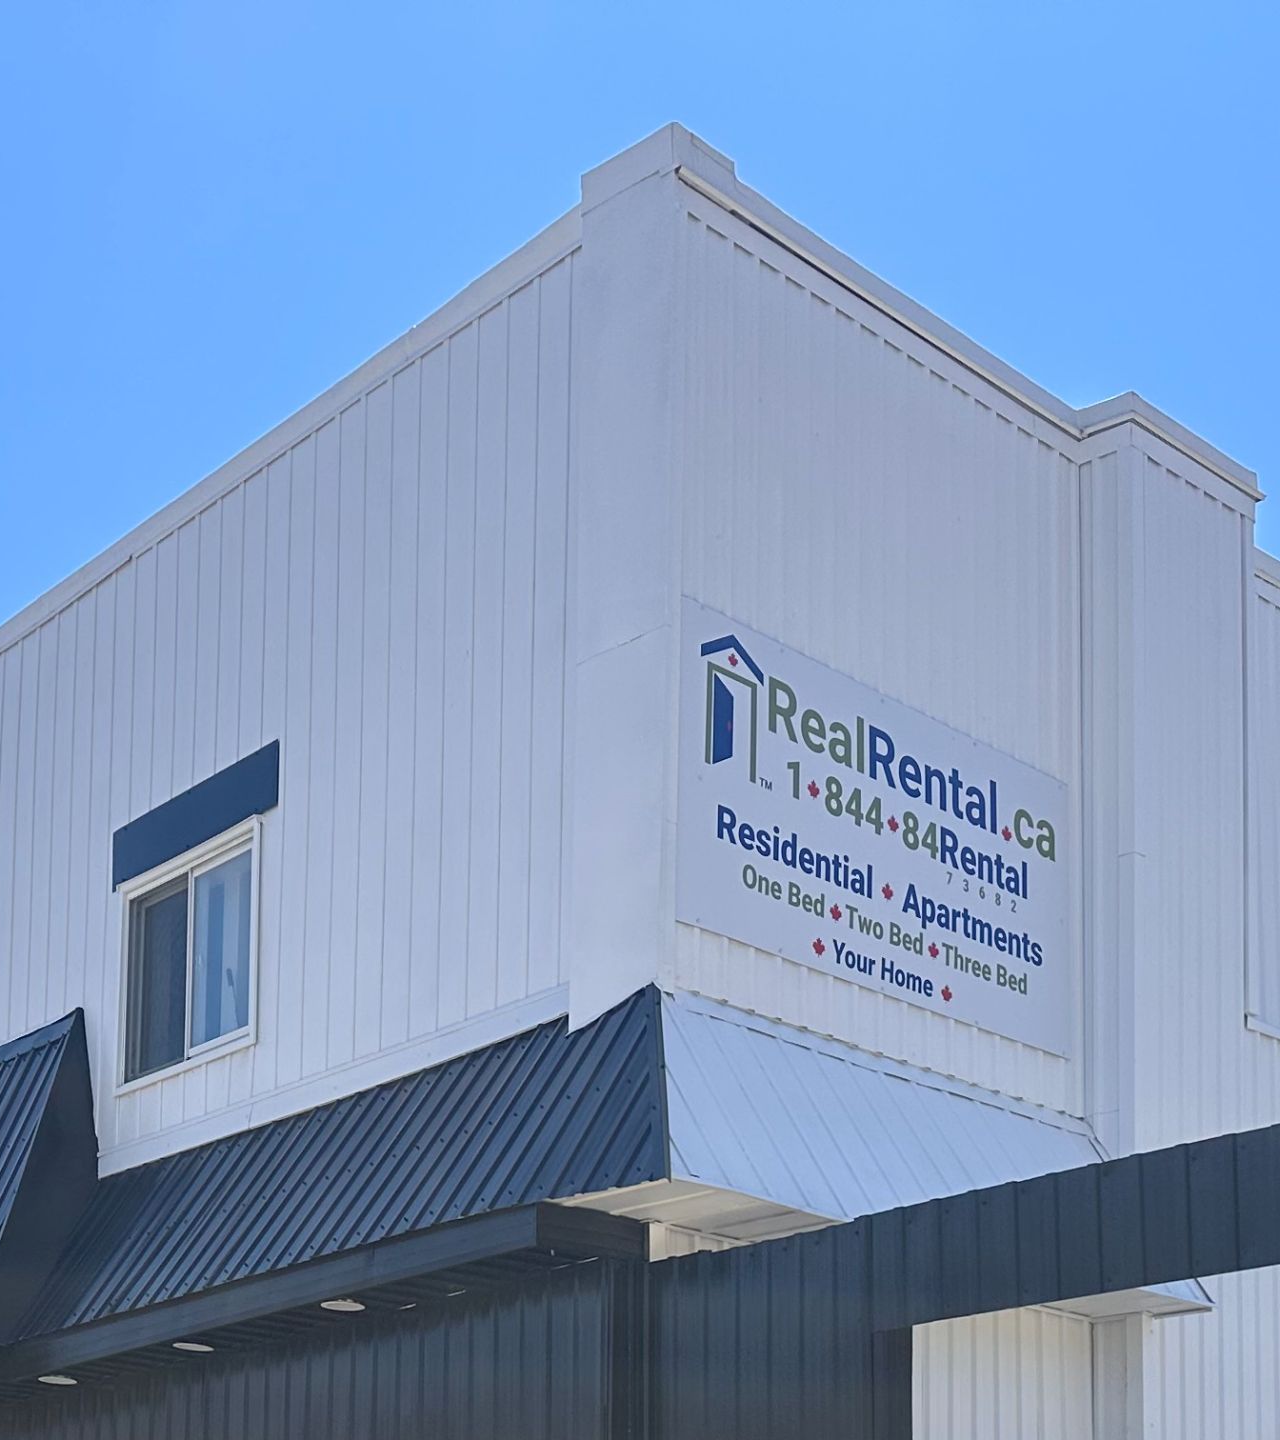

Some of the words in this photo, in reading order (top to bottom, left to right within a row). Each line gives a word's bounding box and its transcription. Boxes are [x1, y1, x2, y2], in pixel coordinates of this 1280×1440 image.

[717, 804, 873, 899] Residential
[901, 883, 1043, 967] Apartments
[742, 864, 782, 900] One
[788, 881, 825, 919] Bed
[845, 904, 884, 941] Two
[889, 921, 924, 956] Bed
[942, 942, 992, 982] Three
[996, 959, 1028, 996] Bed
[832, 939, 876, 976] Your
[881, 957, 934, 998] Home
